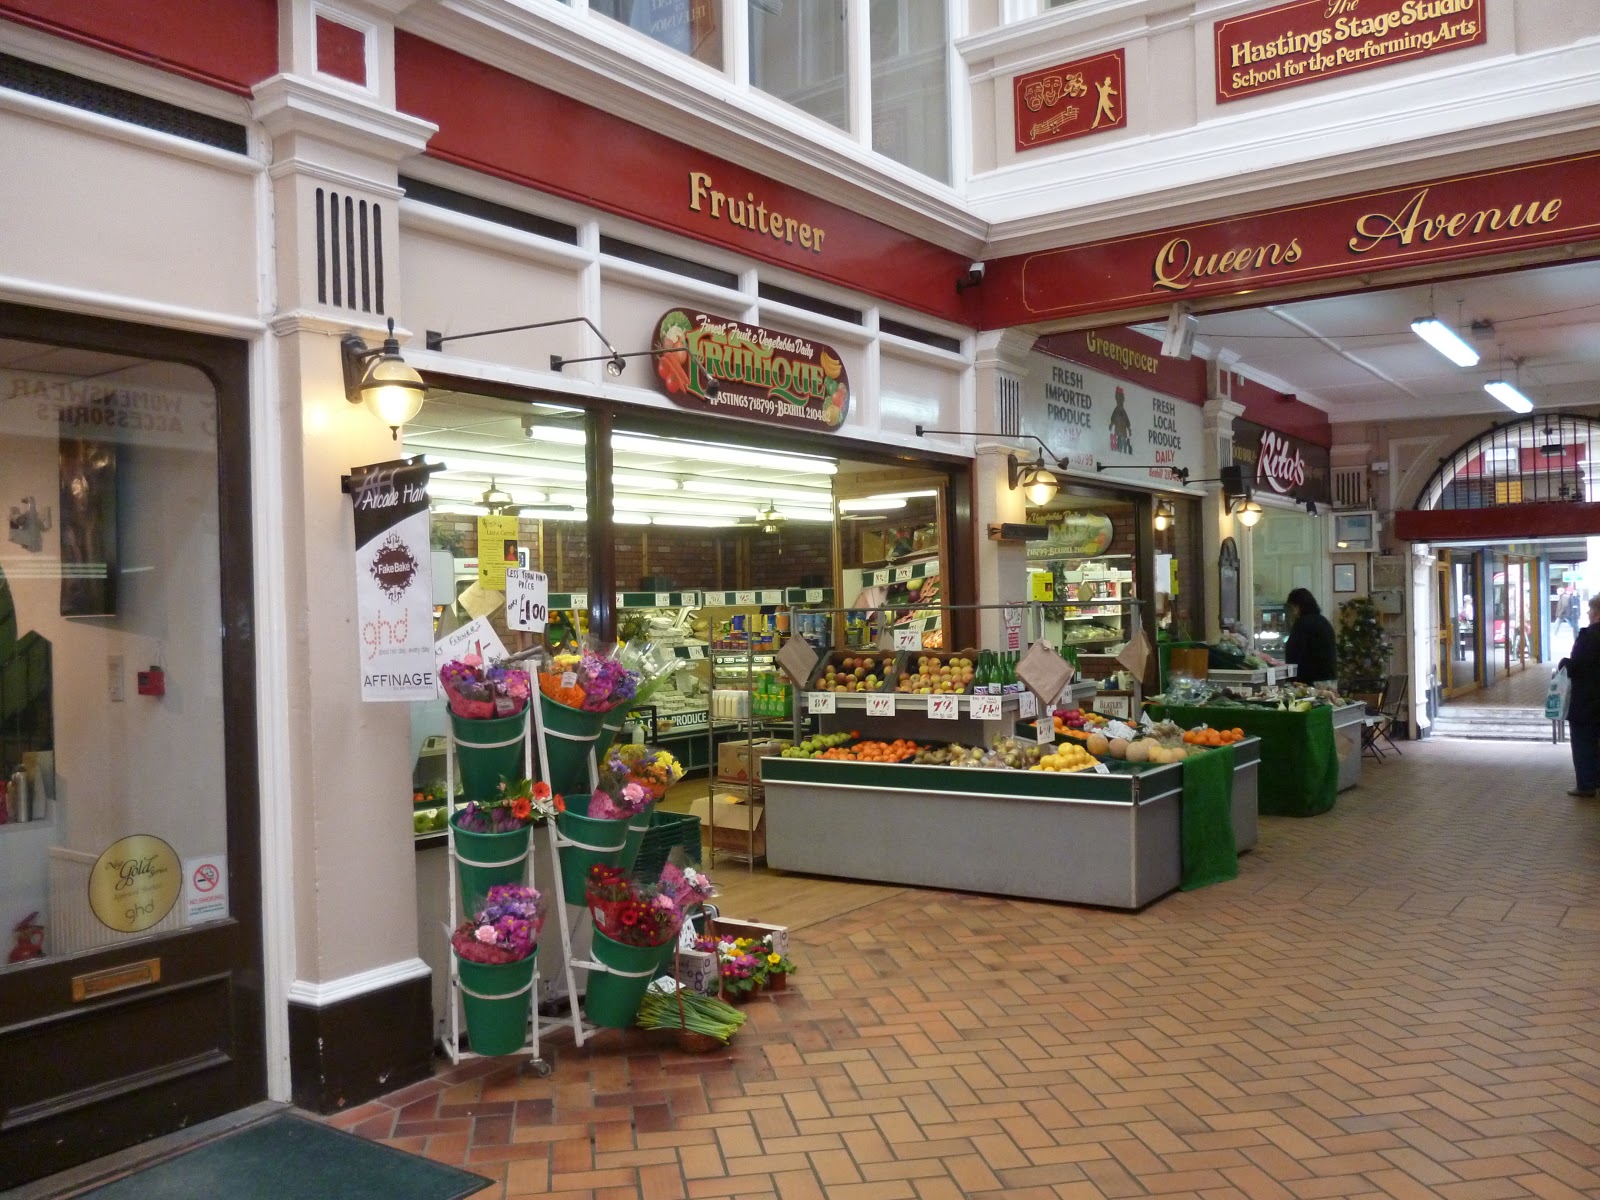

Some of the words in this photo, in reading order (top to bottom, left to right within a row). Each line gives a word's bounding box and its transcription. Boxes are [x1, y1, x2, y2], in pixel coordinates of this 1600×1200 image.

[1323, 0, 1359, 19] The
[1231, 26, 1332, 68] Hastings
[1334, 10, 1400, 42] Stage
[1400, 0, 1473, 25] Studio
[1232, 61, 1282, 89] School
[1283, 57, 1308, 79] for
[1308, 50, 1336, 73] the
[1336, 29, 1434, 66] Performing
[1432, 18, 1477, 44] Arts
[689, 171, 825, 252] Fruiterer
[1152, 236, 1302, 291] Queens
[1348, 188, 1562, 253] Avenue
[696, 315, 727, 336] Finest
[728, 323, 752, 343] Fruit
[758, 328, 796, 353] Vegetables
[795, 338, 814, 360] Daily
[1086, 331, 1159, 375] Greengrocer
[1052, 366, 1084, 390] FRESH
[749, 396, 775, 415] 718799
[777, 400, 805, 417] BEXHILL
[1045, 383, 1092, 410] IMPORTED
[1153, 398, 1176, 417] FRESH
[1047, 402, 1092, 429] PRODUCE
[1153, 415, 1177, 433] LOCAL
[1148, 429, 1182, 450] PRODUCE
[1155, 450, 1176, 464] DAILY
[1256, 431, 1305, 493] Rita's
[362, 487, 399, 511] Arcade
[403, 482, 426, 504] Hair
[507, 569, 519, 579] LESS
[518, 580, 535, 591] PRICE
[363, 608, 408, 660] ghd
[364, 672, 433, 687] AFFINAGE
[671, 712, 707, 726] PRODUCE
[115, 855, 159, 890] Gold
[126, 899, 155, 924] ghd
